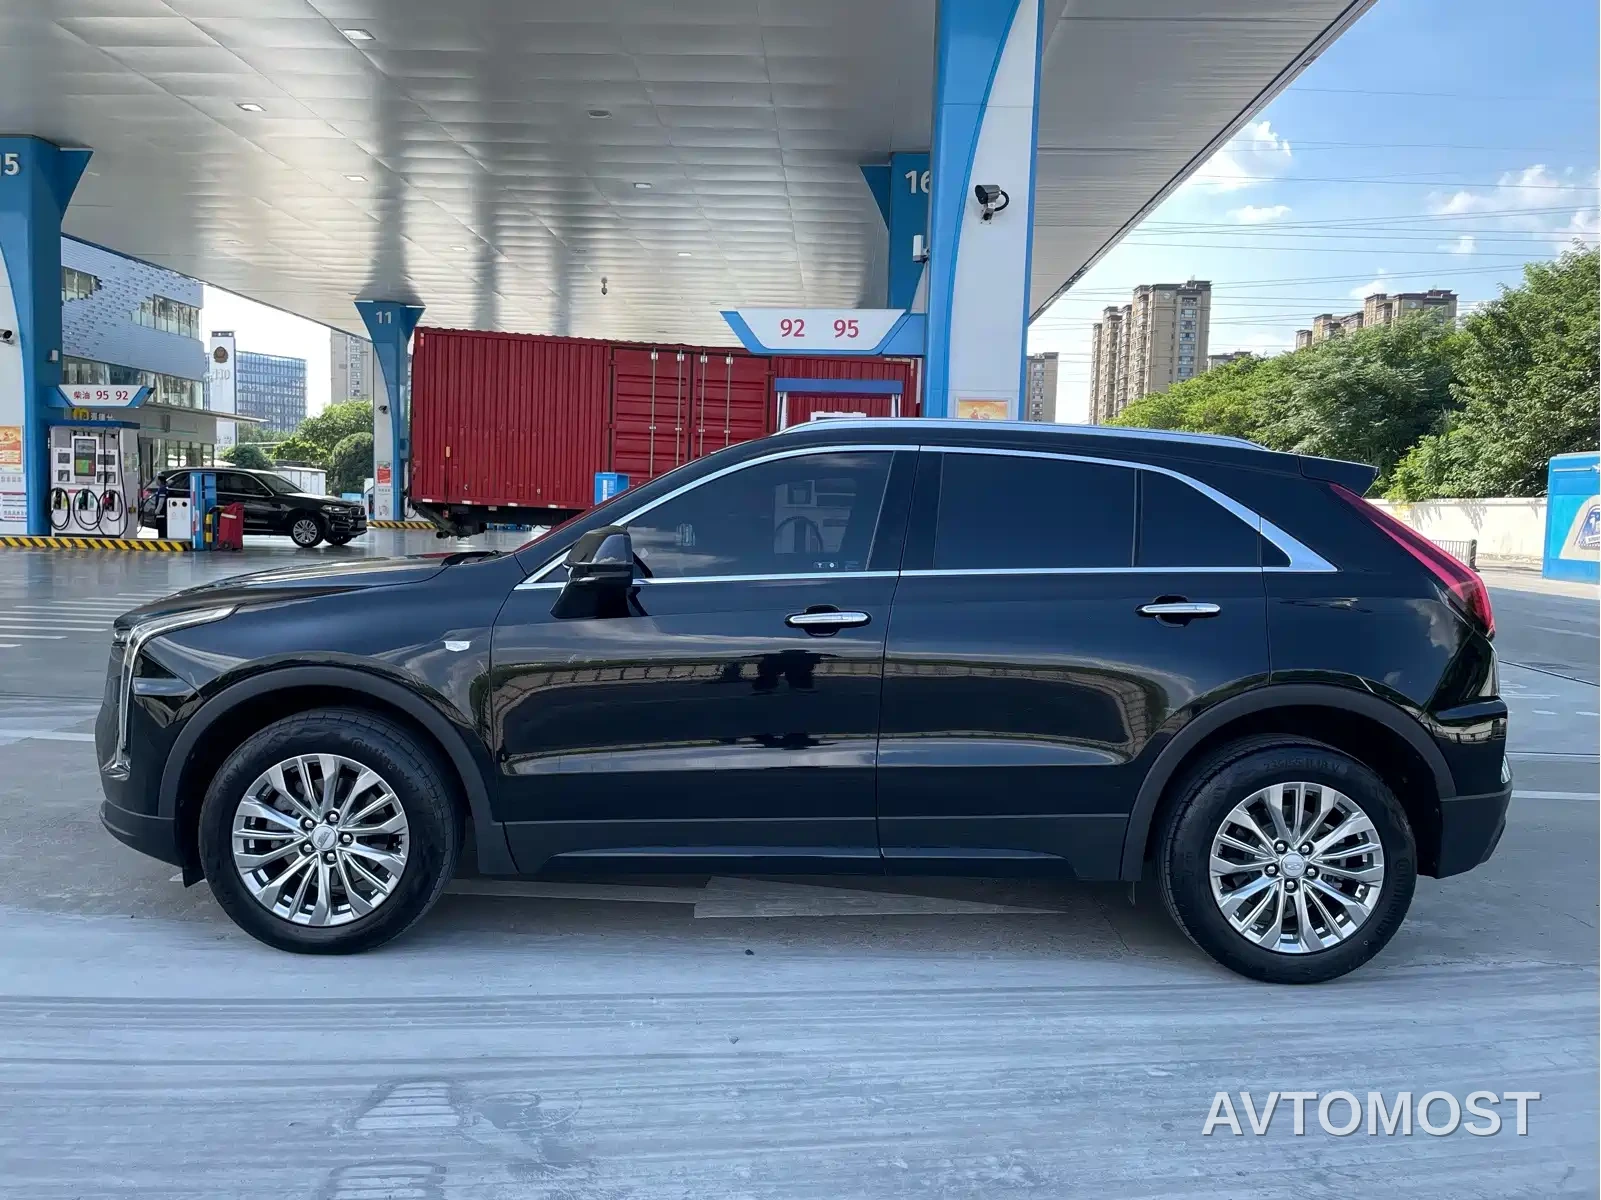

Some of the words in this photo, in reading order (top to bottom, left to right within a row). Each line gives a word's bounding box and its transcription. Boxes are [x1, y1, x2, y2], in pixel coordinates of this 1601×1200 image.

[0, 153, 20, 176] 5
[375, 311, 392, 324] 11
[780, 318, 805, 337] 92
[833, 319, 859, 338] 95
[73, 390, 91, 400] 柴油
[96, 390, 109, 401] 95
[115, 390, 129, 401] 92
